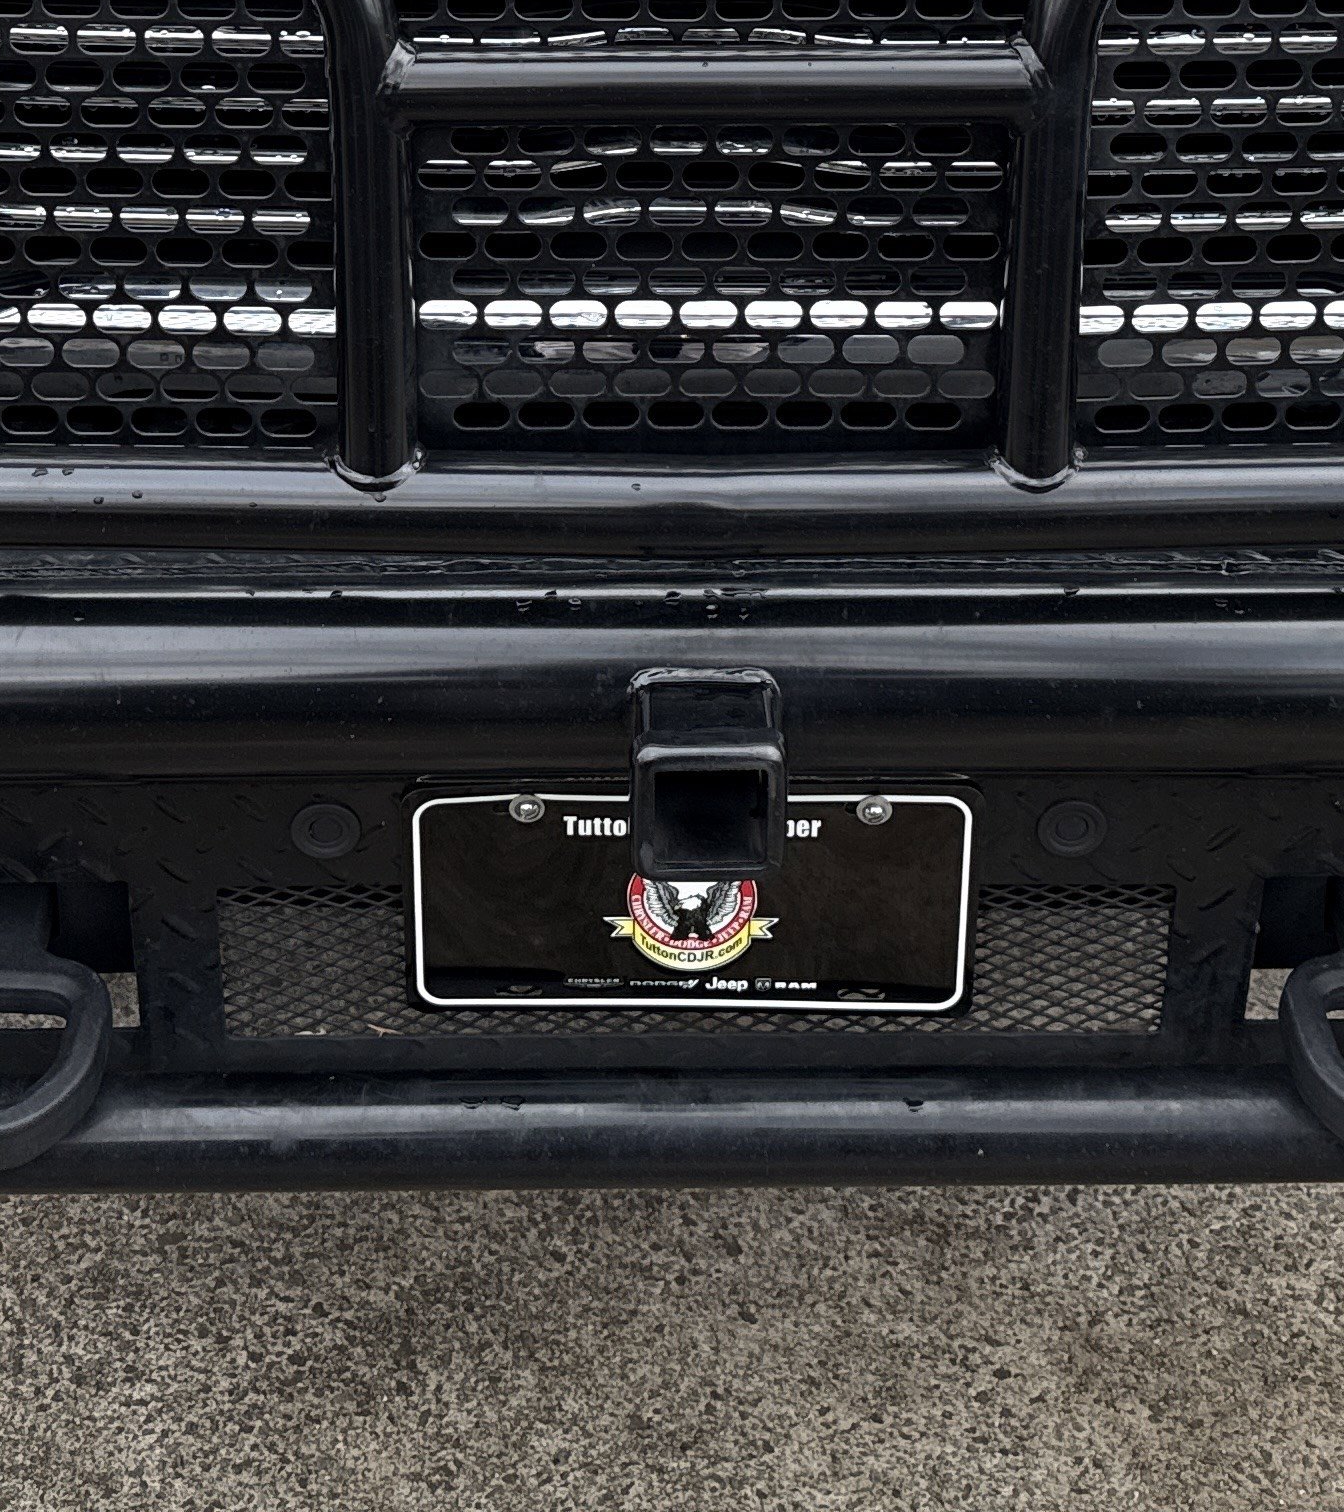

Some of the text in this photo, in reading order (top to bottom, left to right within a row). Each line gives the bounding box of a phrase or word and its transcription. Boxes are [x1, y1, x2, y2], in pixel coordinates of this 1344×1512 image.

[563, 815, 630, 837] Tutto
[640, 933, 743, 962] TuttonCDJR.com
[705, 976, 748, 991] Jeep
